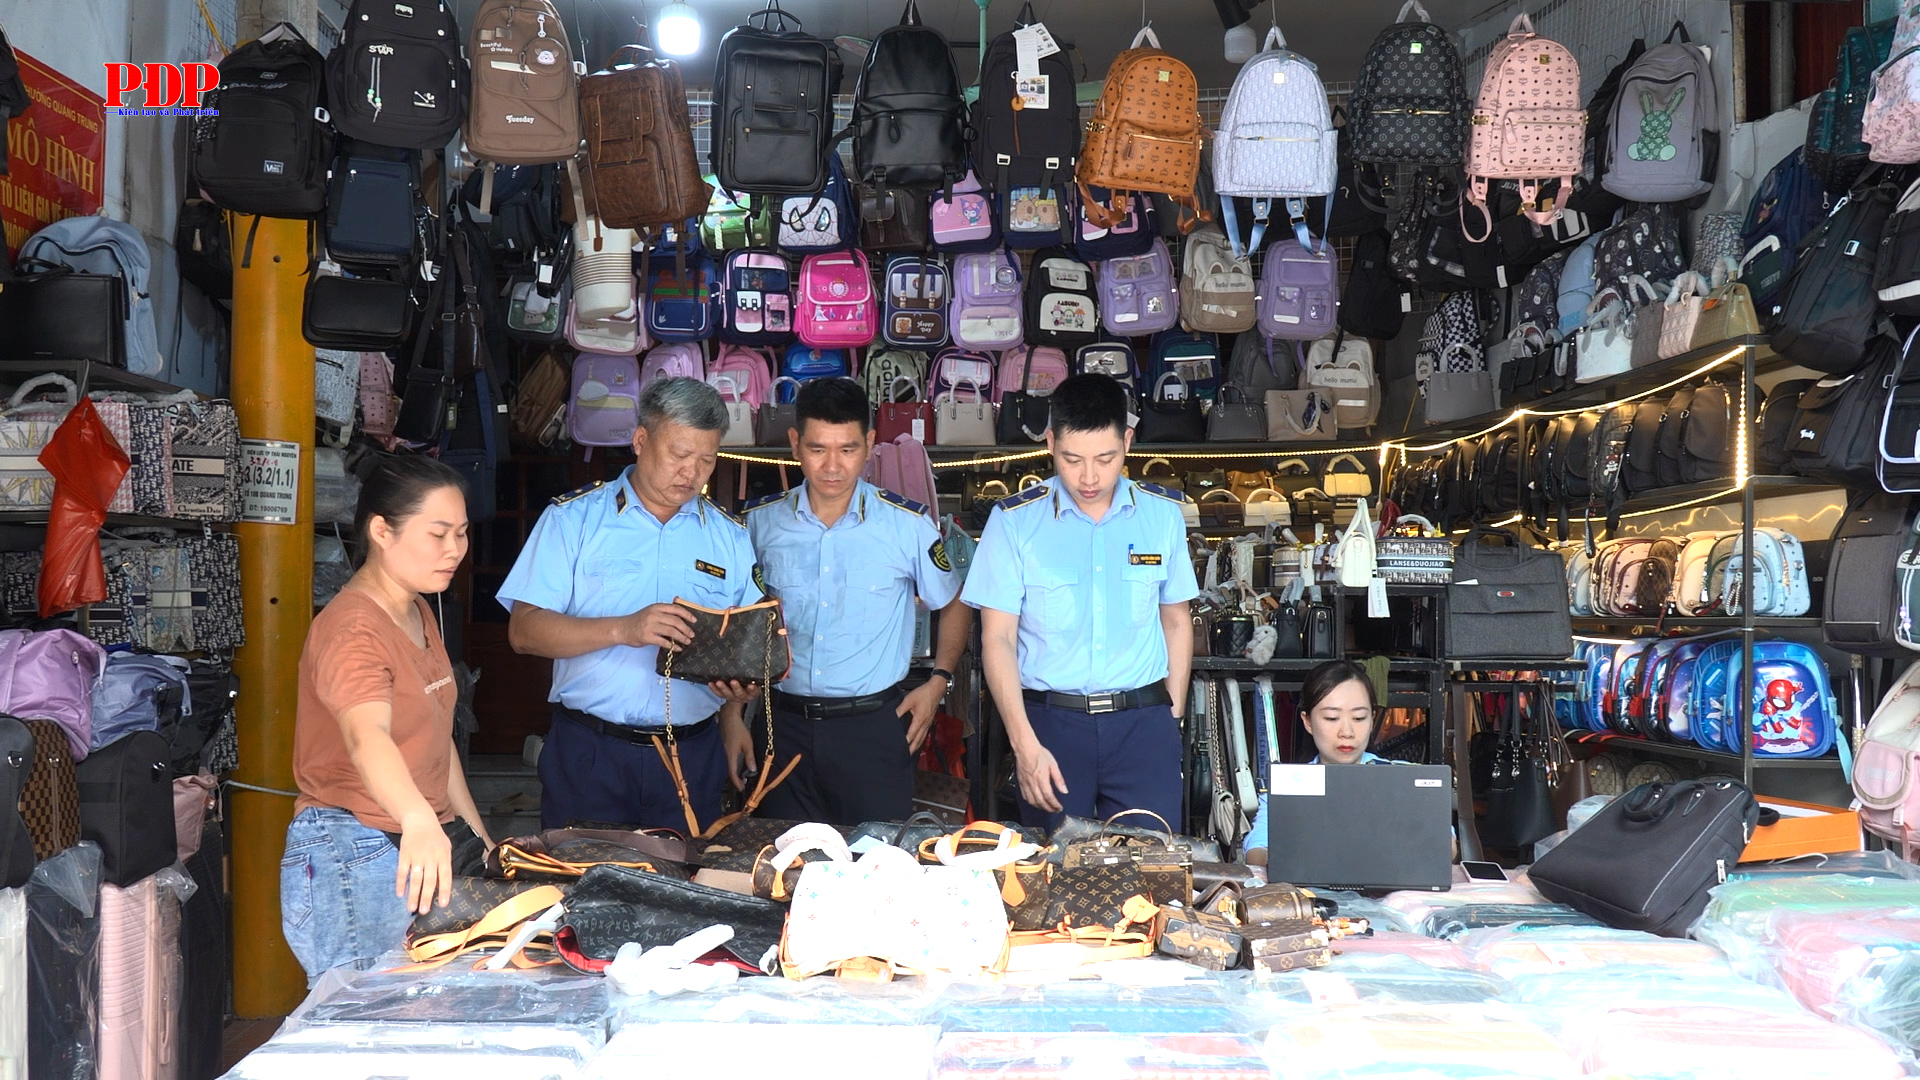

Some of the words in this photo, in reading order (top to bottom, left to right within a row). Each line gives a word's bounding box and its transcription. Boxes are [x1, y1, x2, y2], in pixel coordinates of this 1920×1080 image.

[53, 100, 76, 121] QUANG
[77, 113, 98, 133] TRUNG
[506, 115, 534, 124] Tuesday
[7, 117, 40, 166] MÔ
[45, 135, 95, 194] HÌNH
